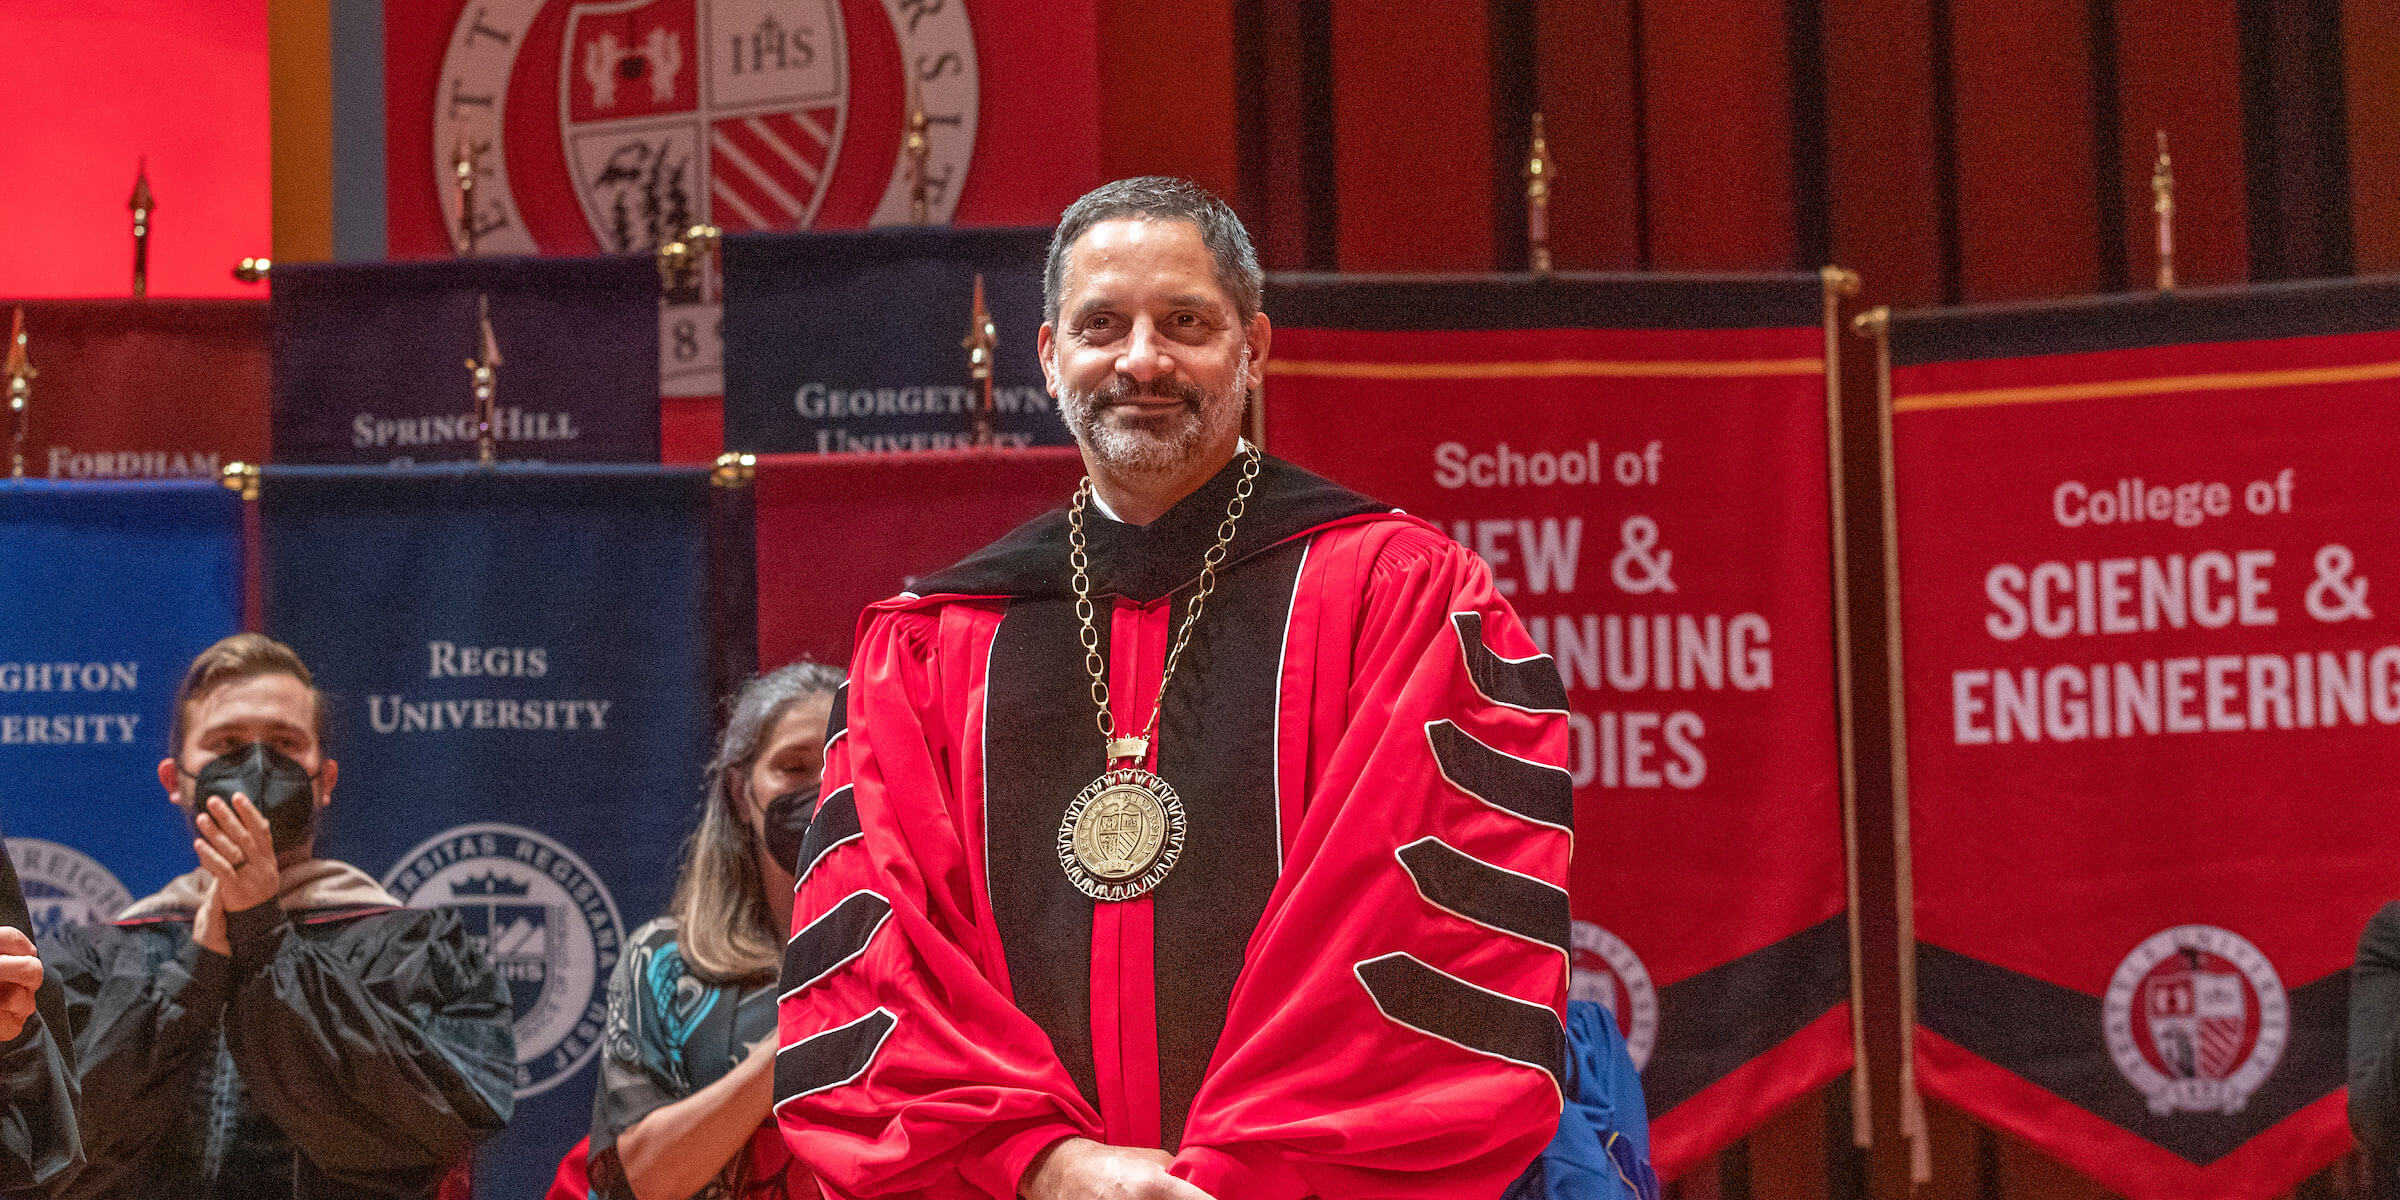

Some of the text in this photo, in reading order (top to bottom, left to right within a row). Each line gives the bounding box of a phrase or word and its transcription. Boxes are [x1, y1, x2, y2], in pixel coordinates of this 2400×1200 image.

[732, 20, 815, 74] IHS
[352, 407, 577, 447] SPRING HILL
[48, 446, 220, 478] FORDHAM
[1433, 440, 1663, 488] School of
[2053, 468, 2296, 527] College of
[1611, 515, 1677, 594] &
[1984, 543, 2375, 641] SCIENCE &
[428, 640, 548, 678] REGIS
[1526, 612, 1773, 692] INUING
[0, 662, 138, 692] GHTON
[1952, 645, 2400, 745] ENGINEERING
[0, 714, 139, 744] ERSITY
[368, 694, 612, 734] UNIVERSITY
